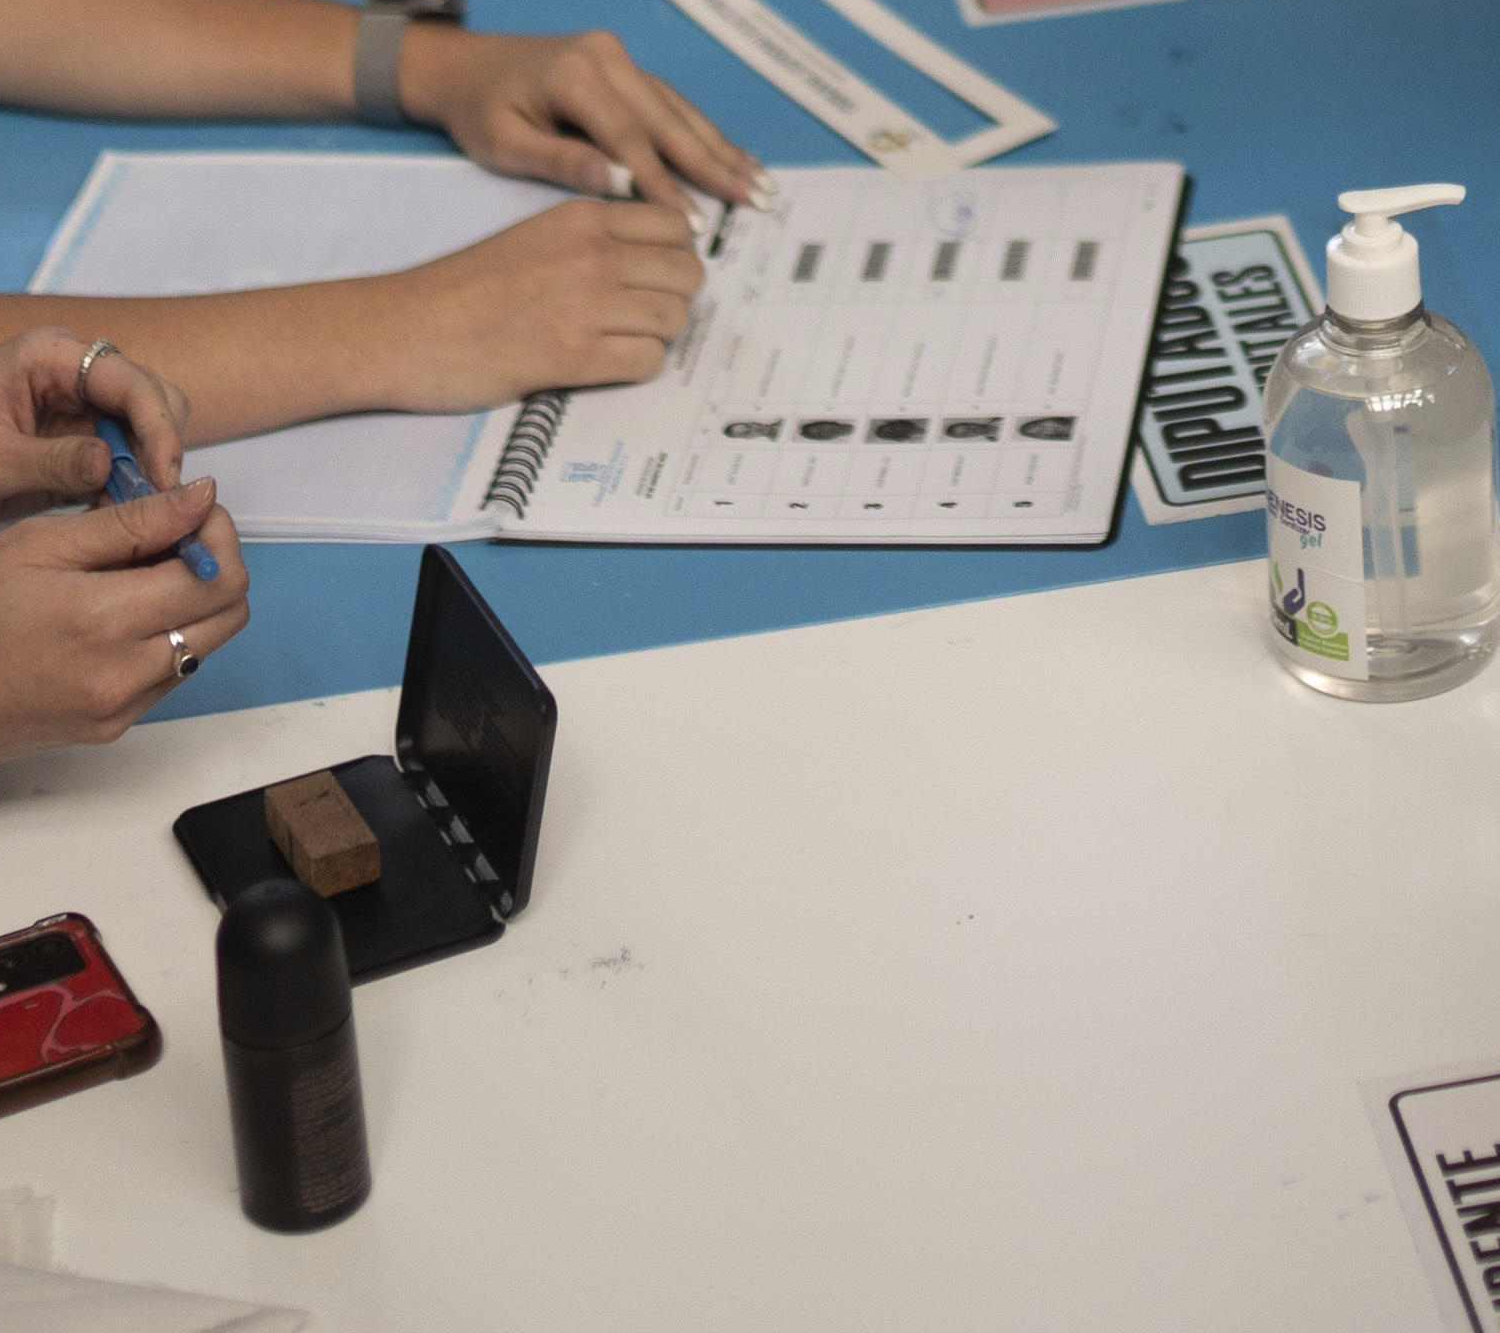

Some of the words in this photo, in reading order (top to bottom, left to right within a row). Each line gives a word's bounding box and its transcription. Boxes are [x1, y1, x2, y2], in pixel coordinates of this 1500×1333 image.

[1143, 253, 1266, 491] DIPUTAD
[789, 501, 809, 510] 2
[862, 502, 885, 511] 3
[938, 500, 959, 509] 4
[1300, 533, 1323, 550] gel
